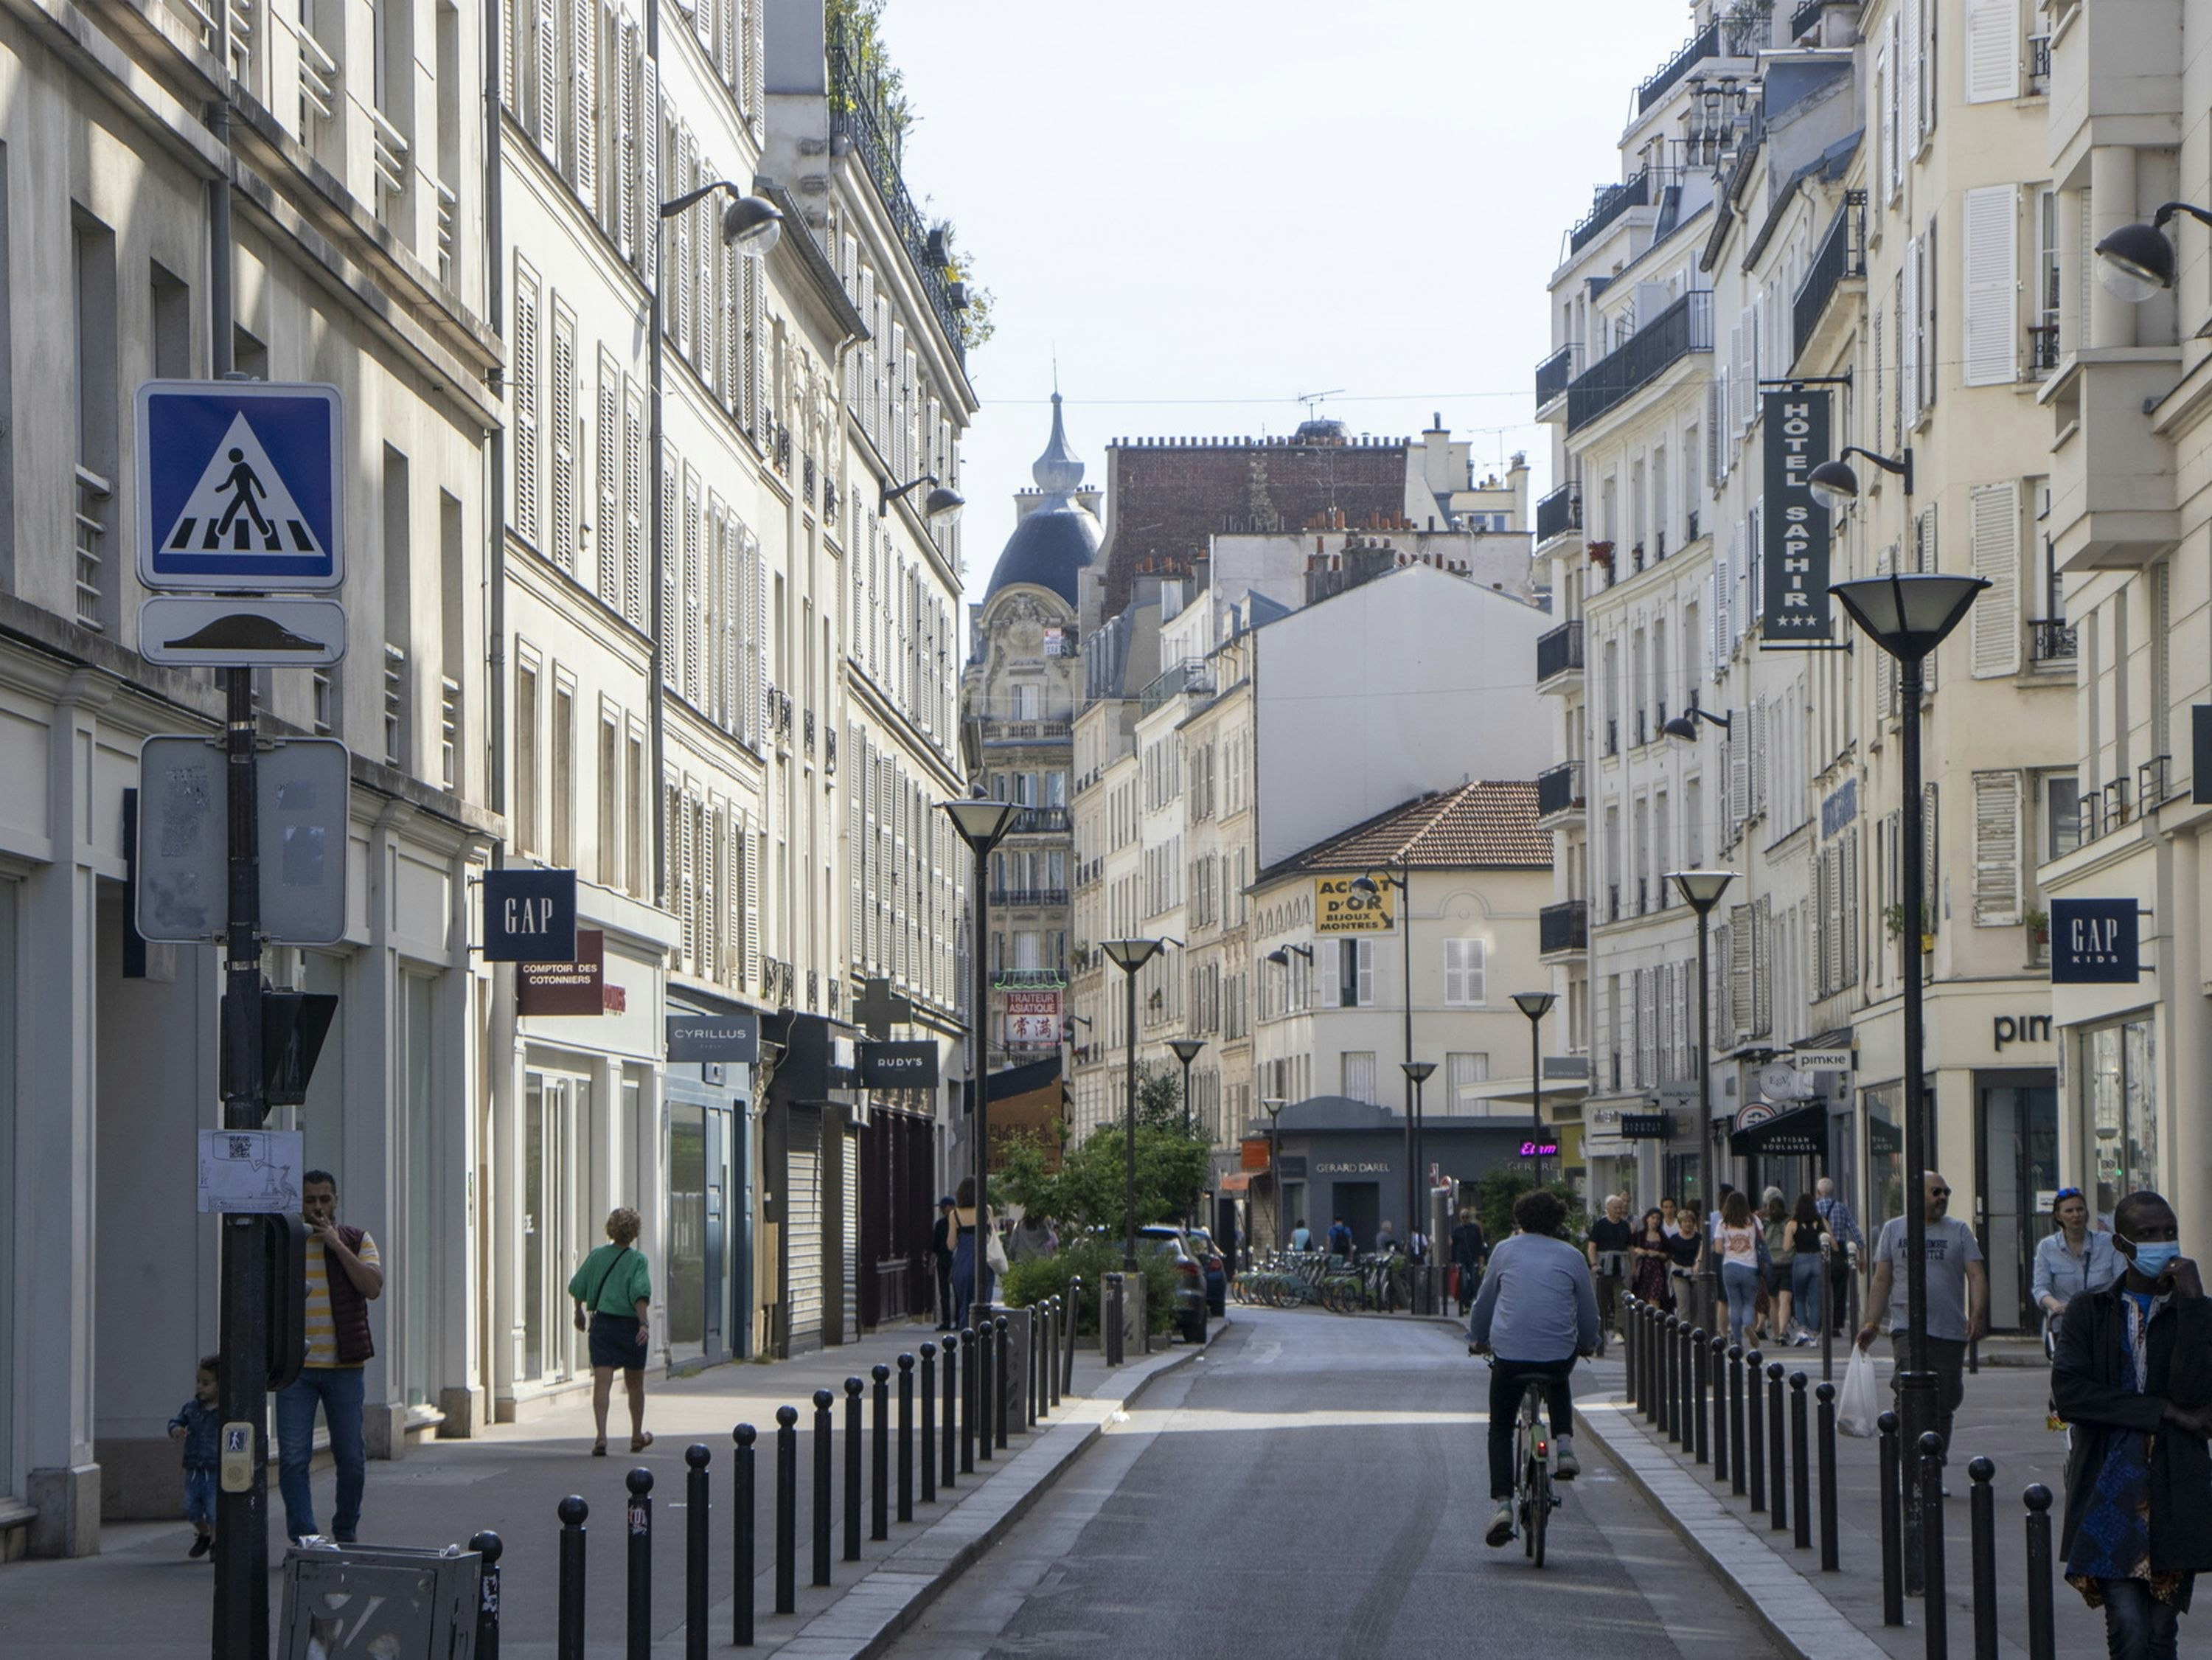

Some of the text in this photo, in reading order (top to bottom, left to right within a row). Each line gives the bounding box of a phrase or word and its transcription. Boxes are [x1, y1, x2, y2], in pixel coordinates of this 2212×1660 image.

[1784, 403, 1810, 607] HÔTEL SAPHIR
[1320, 879, 1391, 894] ACT
[1328, 895, 1382, 911] D'OR
[504, 897, 553, 934] GAP
[1326, 913, 1371, 921] BIJOUX
[1320, 921, 1379, 931] MONTRES
[2072, 918, 2118, 952] GAP
[2072, 955, 2118, 963] KIDS
[523, 964, 597, 973] COMPTOIR DES
[529, 976, 591, 984] COTONNIERS
[1009, 993, 1054, 1003] TRAITEUR
[1009, 1004, 1056, 1013] ASIATIQUE
[674, 1029, 747, 1039] CYRILLUS
[877, 1058, 923, 1066] RUDY'S
[1316, 1163, 1391, 1173] GERARD DAREL
